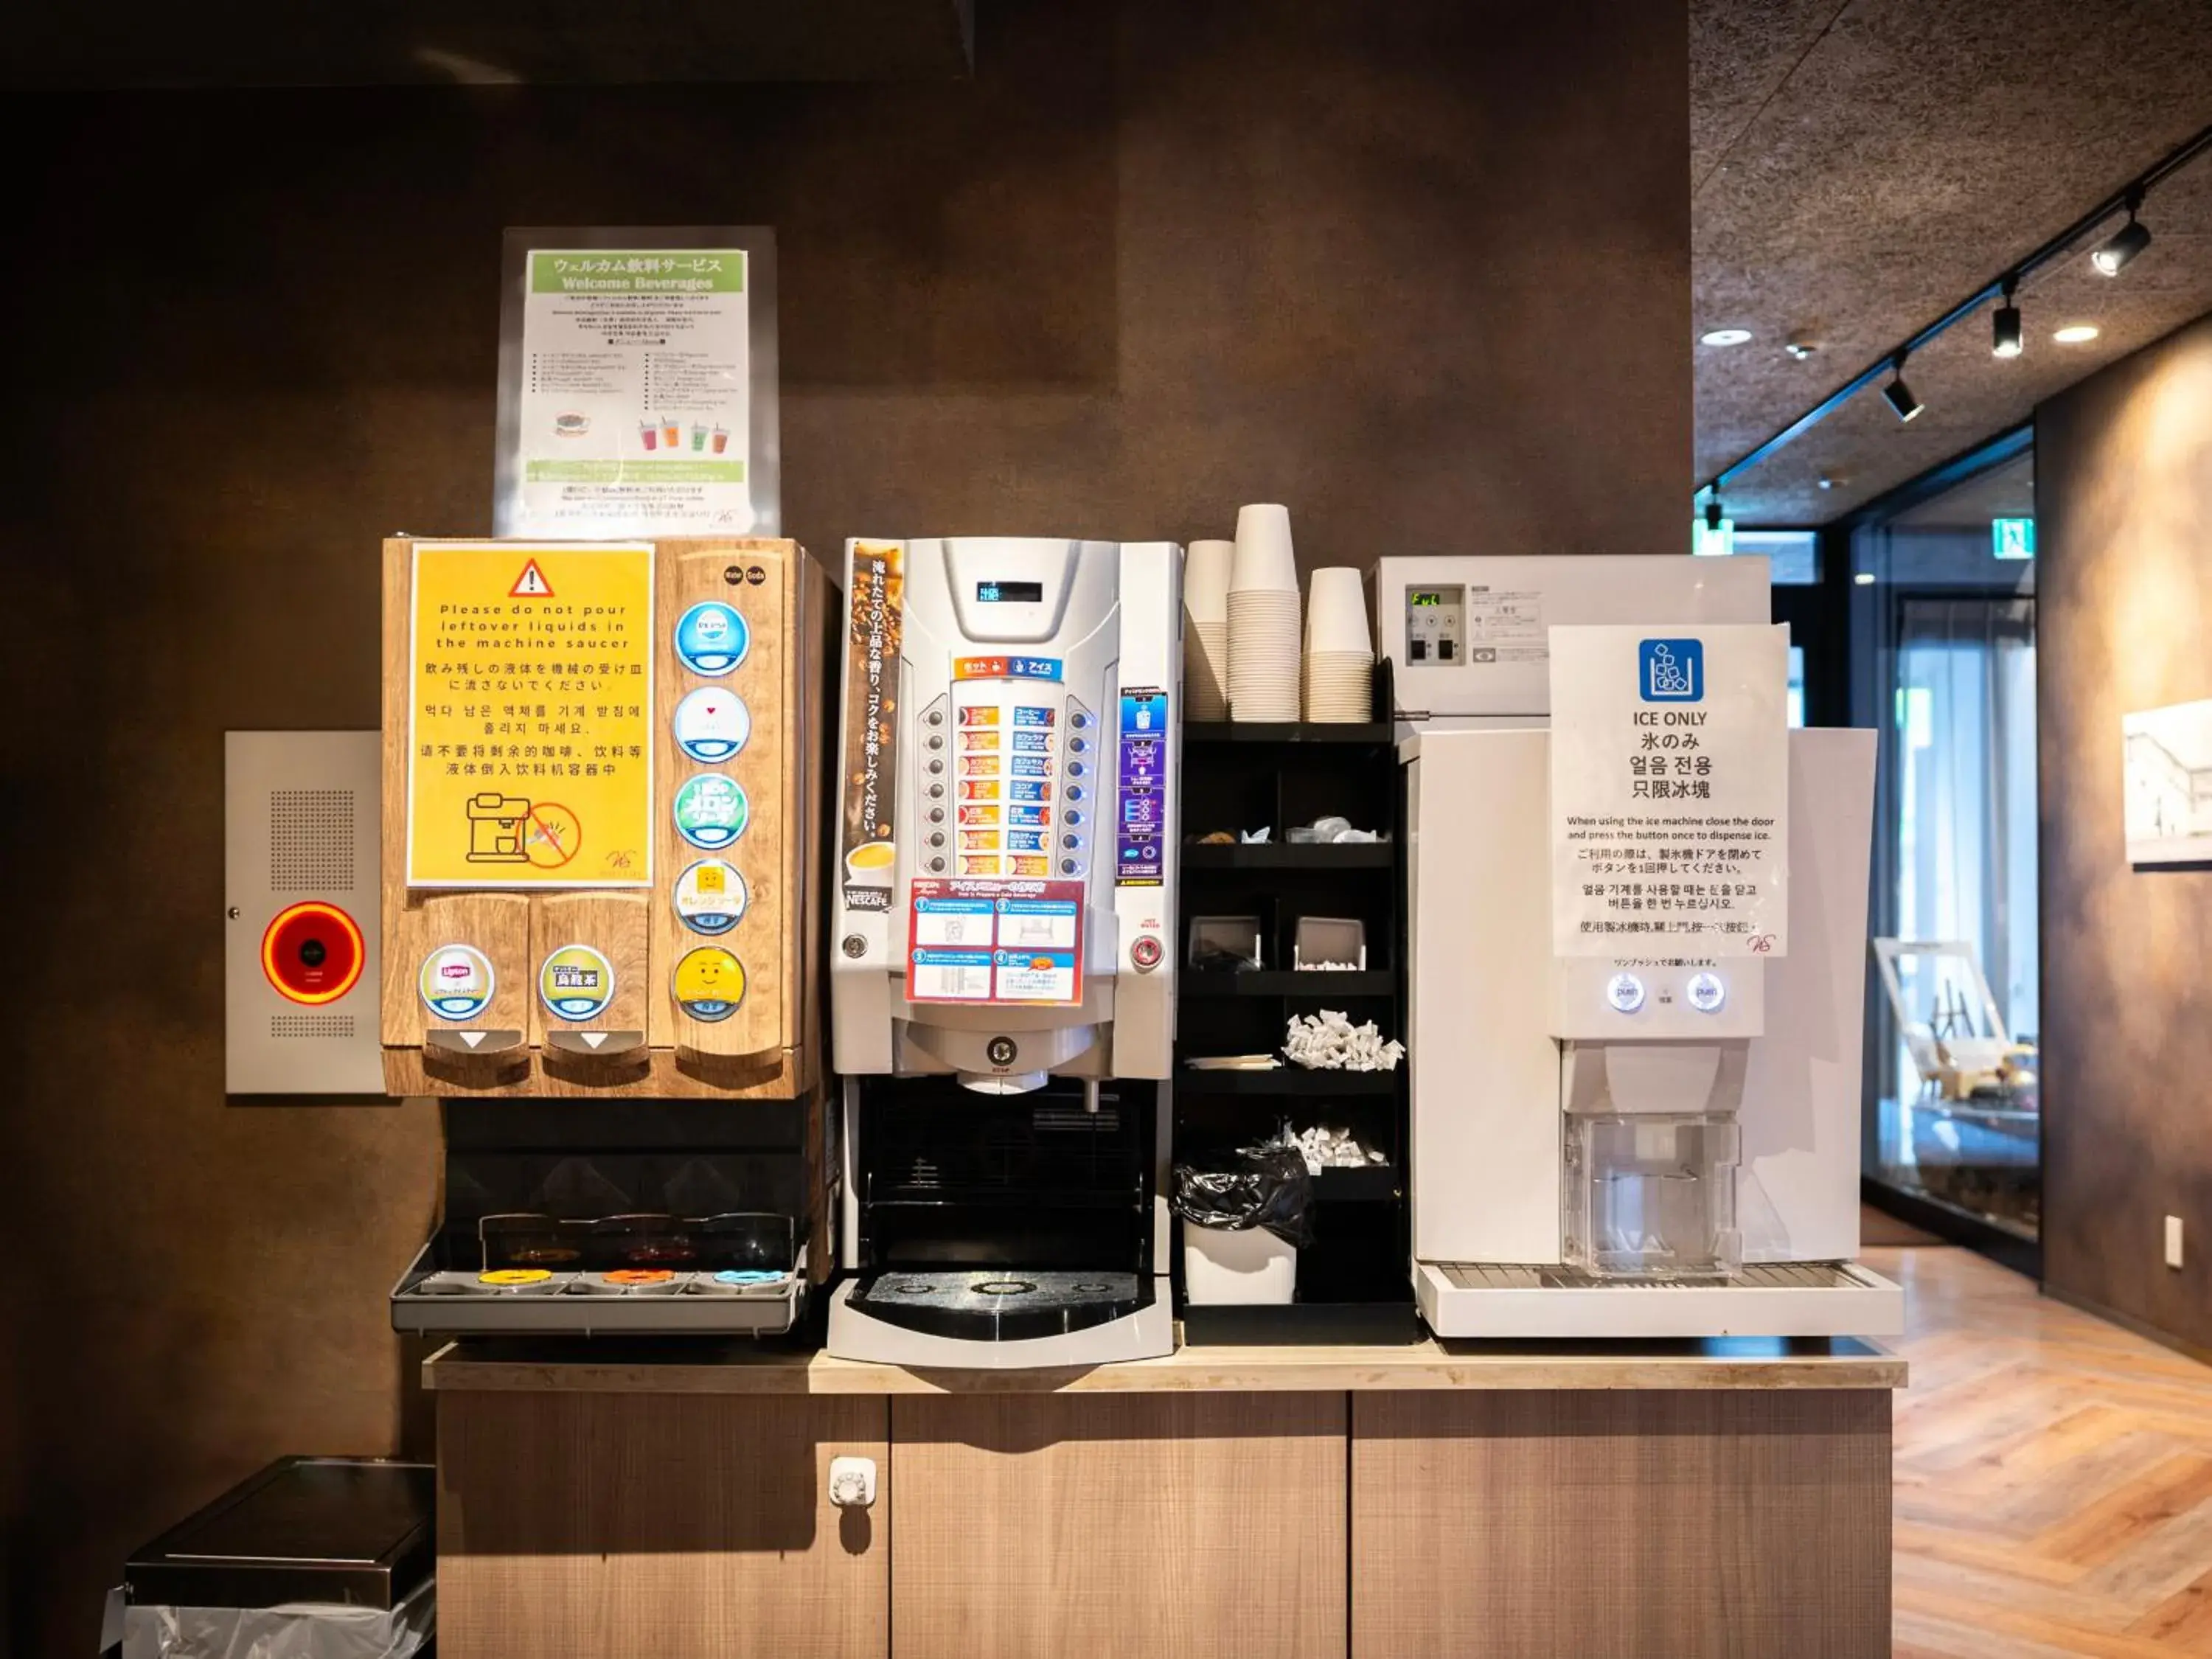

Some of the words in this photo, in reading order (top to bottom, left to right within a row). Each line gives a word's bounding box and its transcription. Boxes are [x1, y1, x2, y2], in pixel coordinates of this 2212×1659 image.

[554, 258, 723, 274] ウェルカム飲料サービス
[562, 277, 630, 290] Welcome
[635, 277, 714, 292] Beverages
[440, 605, 501, 615] Please
[512, 605, 533, 615] do
[543, 605, 574, 615] not
[583, 605, 627, 617] pour
[441, 622, 519, 633] leftover
[529, 622, 597, 634] liquids
[608, 622, 625, 632] in
[437, 639, 467, 649] the
[476, 639, 556, 649] machine
[566, 639, 629, 649] saucer
[425, 662, 643, 675] 飲み残しの液体を機械の受け皿
[425, 705, 453, 717] 먹다
[464, 705, 493, 717] 남은
[503, 705, 547, 717] 액체를
[558, 705, 585, 717] 기계
[597, 705, 640, 717] 받침에
[1632, 712, 1658, 726] ICE
[1663, 712, 1707, 726] ONLY
[538, 722, 590, 735] 마세요.
[1641, 732, 1700, 751] 氷のみ
[445, 763, 616, 776] 液体倒入饮料机容器中
[1630, 756, 1668, 776] 얼음
[1674, 756, 1712, 776] 전용
[1632, 780, 1711, 799] 只限冰塊
[1567, 816, 1596, 826] When
[1599, 816, 1624, 828] using
[1627, 816, 1644, 826] the
[1646, 816, 1660, 826] ice
[1662, 816, 1703, 826] machine
[1705, 816, 1731, 826] close
[1733, 816, 1749, 826] the
[1751, 816, 1775, 826] door
[1568, 830, 1586, 839] and
[1588, 830, 1615, 841] press
[1617, 830, 1633, 839] the
[1636, 830, 1669, 839] button
[1672, 830, 1694, 839] once
[1697, 830, 1707, 839] to
[1710, 830, 1751, 841] dispense
[1754, 830, 1771, 839] ice.
[1577, 848, 1762, 860] ご利用の際は、製氷機ドアを閉めて
[1591, 862, 1742, 874] ボタンを1回押してください。
[1582, 884, 1605, 896] 얼음
[1608, 884, 1643, 896] 기계를
[1646, 884, 1680, 896] 사용할
[1683, 884, 1705, 896] 때는
[1735, 884, 1757, 896] 닫고
[1608, 898, 1643, 910] 버튼을
[1646, 898, 1657, 910] 한
[1660, 898, 1672, 910] 번
